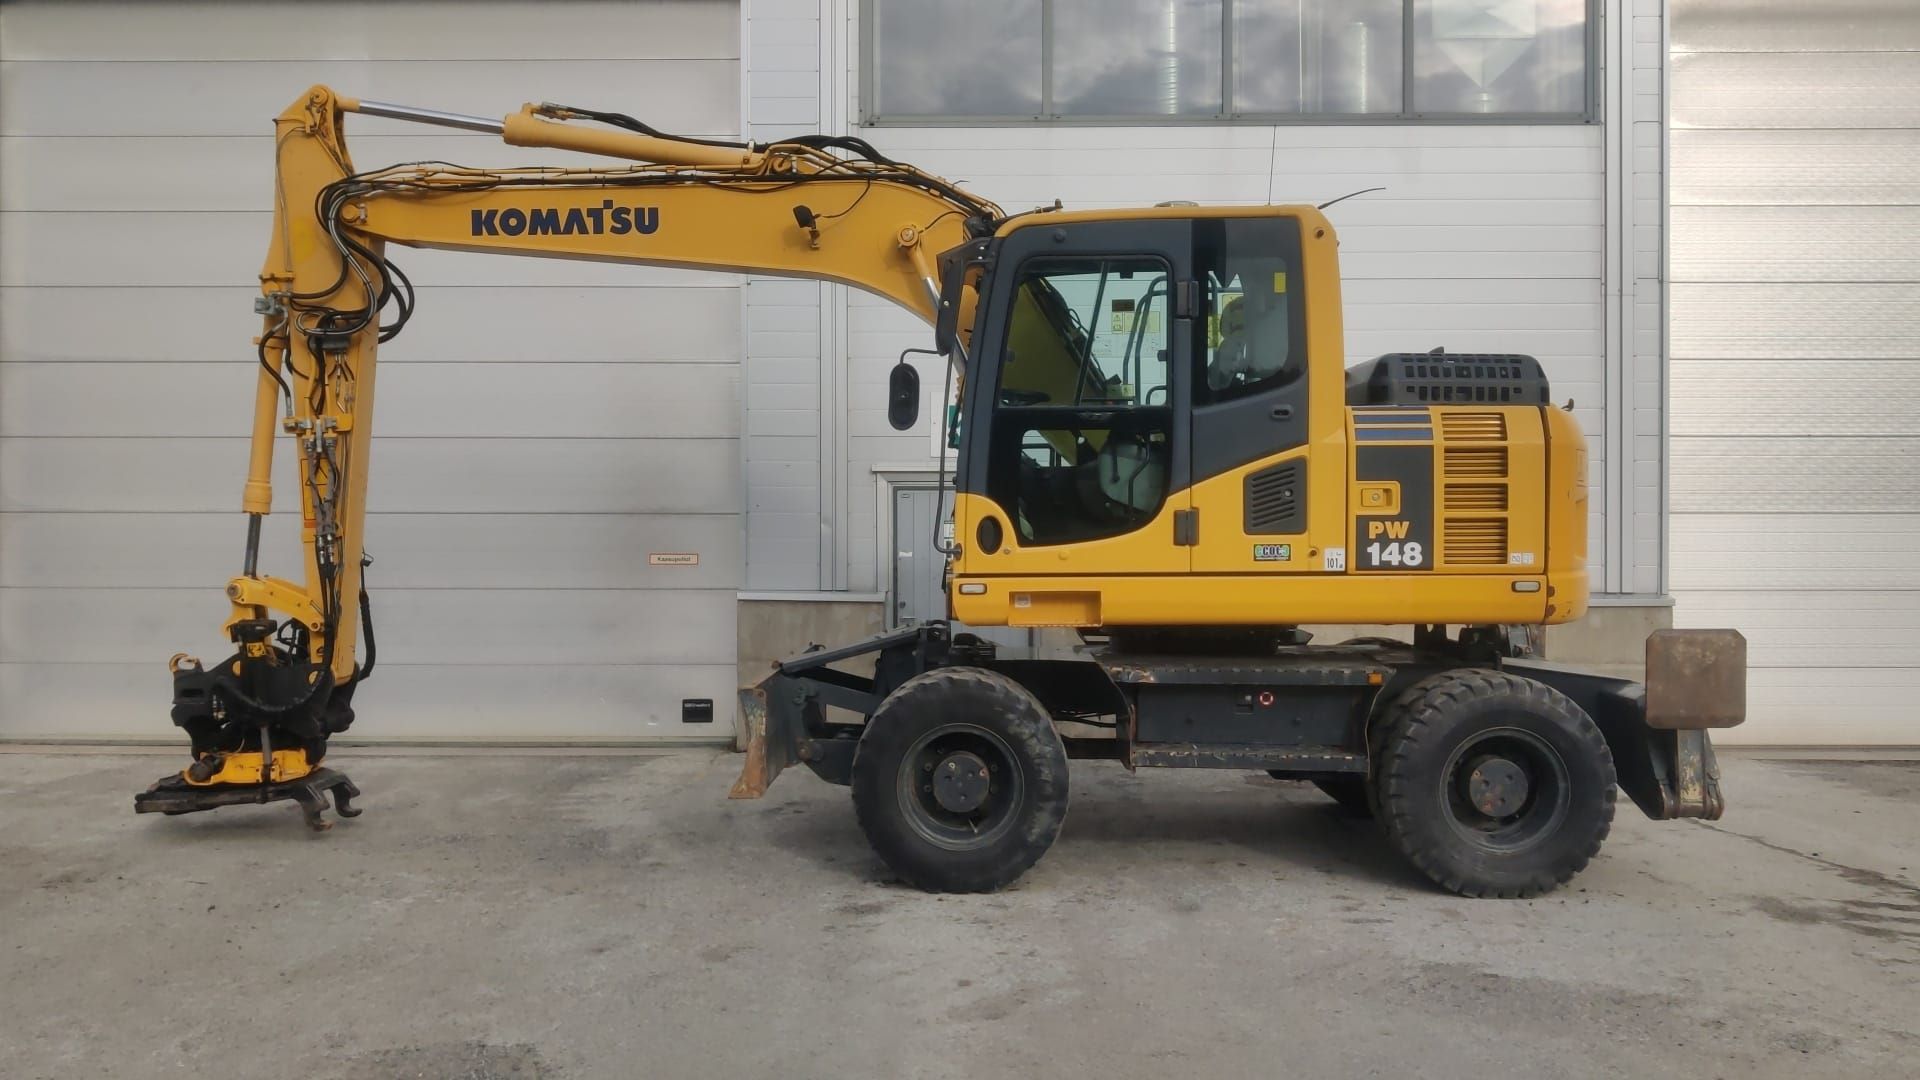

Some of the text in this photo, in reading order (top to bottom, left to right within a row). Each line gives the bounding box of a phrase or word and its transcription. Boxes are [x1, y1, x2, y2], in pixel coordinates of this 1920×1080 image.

[471, 200, 659, 236] KOMATSU
[1368, 521, 1410, 539] PW
[1367, 542, 1423, 566] 148
